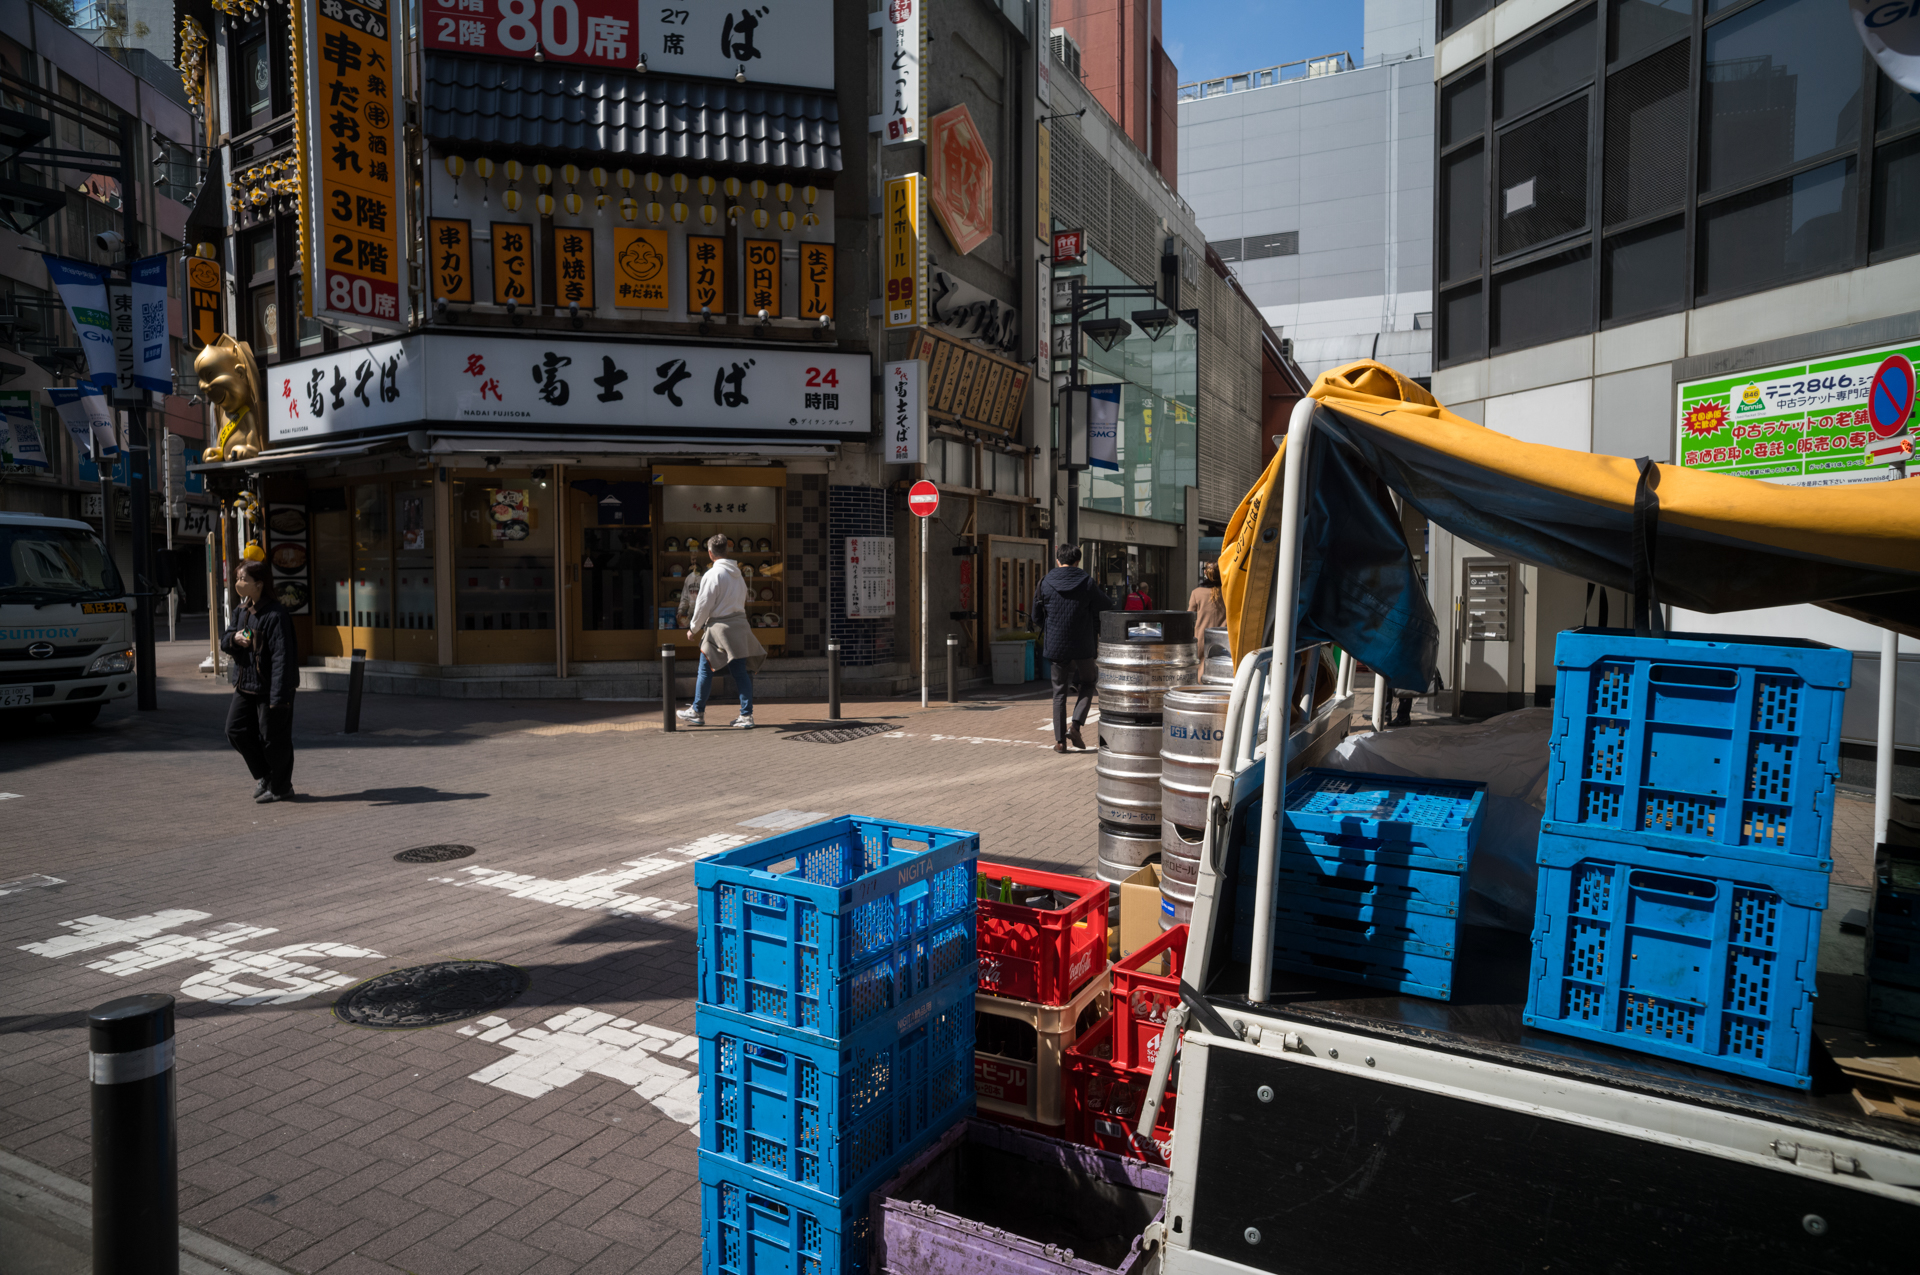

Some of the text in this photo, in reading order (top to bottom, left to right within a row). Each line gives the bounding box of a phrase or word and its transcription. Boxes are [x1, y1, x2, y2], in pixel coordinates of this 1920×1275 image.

[437, 17, 487, 48] 2階
[496, 0, 631, 61] 80席
[720, 5, 770, 62] ば
[323, 30, 363, 175] 串だおれ
[331, 189, 388, 233] 3階
[894, 189, 907, 268] ハイボール
[332, 234, 389, 276] 2階
[439, 225, 463, 295] 串カツ
[1056, 235, 1078, 261] 質
[502, 231, 525, 298] おでん
[562, 234, 586, 301] 串焼き
[696, 242, 717, 307] 串カツ
[749, 245, 777, 309] 50円串
[329, 274, 397, 318] 80席
[619, 282, 664, 299] 串だおれ
[807, 248, 829, 314] 生ビール
[194, 291, 218, 310] IN
[306, 349, 404, 418] 富士そば
[462, 353, 503, 402] 名代
[532, 351, 757, 409] 富士そば
[805, 367, 840, 389] 24
[894, 366, 909, 381] 名代
[282, 378, 300, 419] 名代
[804, 392, 840, 411] 時間
[1739, 403, 1763, 412] Tennis
[1743, 390, 1759, 398] 846
[1776, 387, 1871, 410] 中古ラケット専門店
[463, 410, 532, 418] NADAI FUJISOBA
[894, 381, 910, 443] 富士そば
[1731, 408, 1871, 440] 中古ラケットの老舗
[280, 426, 309, 435] NADAI FUJISOBA
[1088, 430, 1117, 438] GMO
[895, 445, 909, 454] 24
[703, 502, 748, 513] 富士そば
[82, 602, 127, 614] 高圧ガス
[1111, 810, 1138, 820] サントリー
[898, 857, 934, 885] NIGITA
